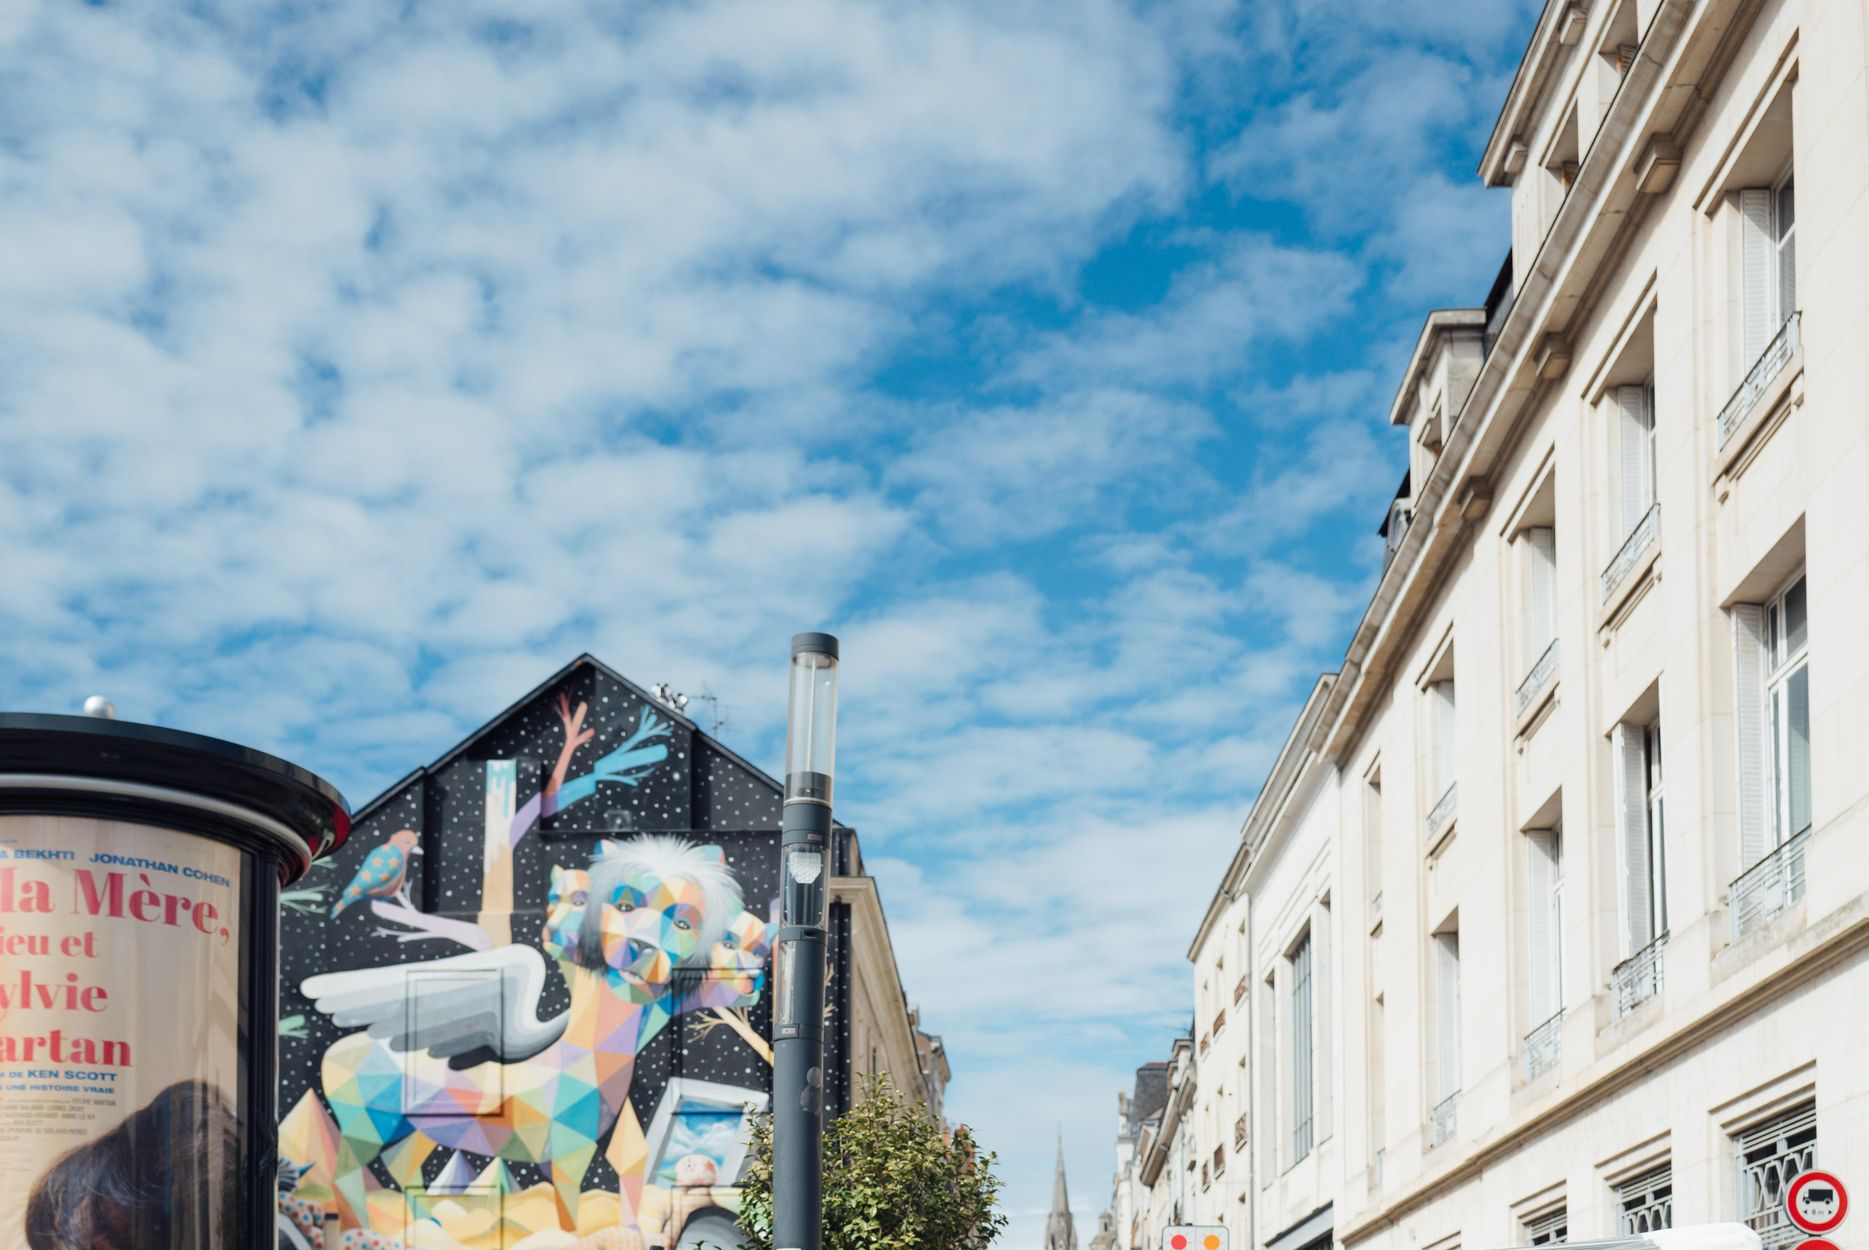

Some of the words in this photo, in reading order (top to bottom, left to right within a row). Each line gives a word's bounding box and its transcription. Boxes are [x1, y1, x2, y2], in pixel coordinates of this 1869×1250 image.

[14, 848, 75, 861] BEKHTI
[89, 852, 178, 875] JONATHAN
[183, 866, 230, 888] COHEN
[0, 866, 56, 914] la
[71, 868, 230, 947] Mère,
[60, 930, 99, 959] et
[27, 1069, 59, 1079] KEN
[64, 1071, 118, 1082] SCOTT
[30, 1084, 80, 1092] HISTOIRE
[83, 1086, 115, 1094] VRAIE
